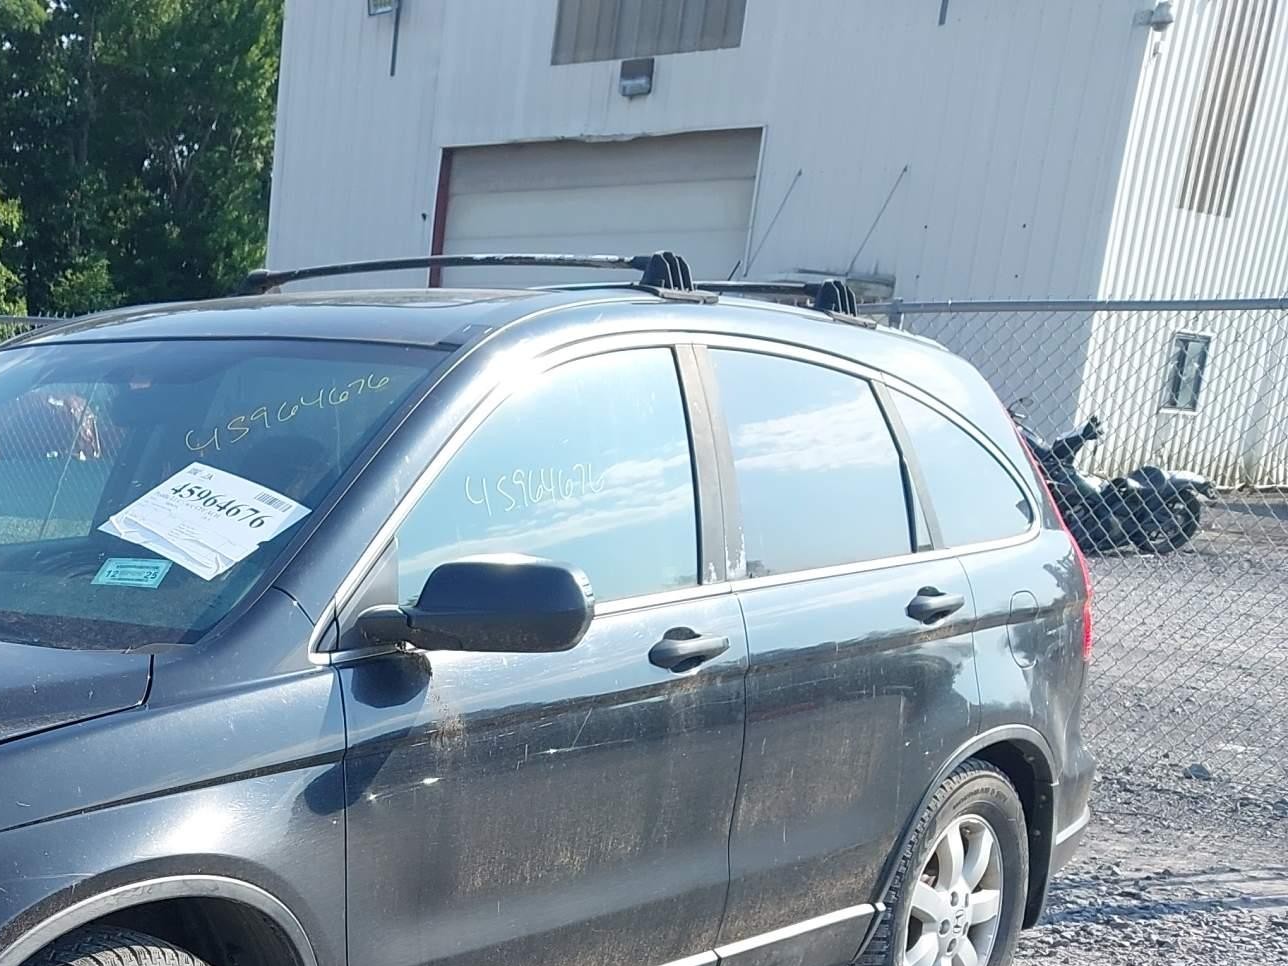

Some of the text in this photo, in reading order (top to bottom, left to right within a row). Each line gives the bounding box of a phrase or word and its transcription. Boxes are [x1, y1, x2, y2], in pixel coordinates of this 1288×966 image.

[185, 374, 390, 452] 45964676
[170, 482, 274, 529] 45964676
[464, 463, 606, 517] 45964676
[105, 569, 159, 579] 12 25
